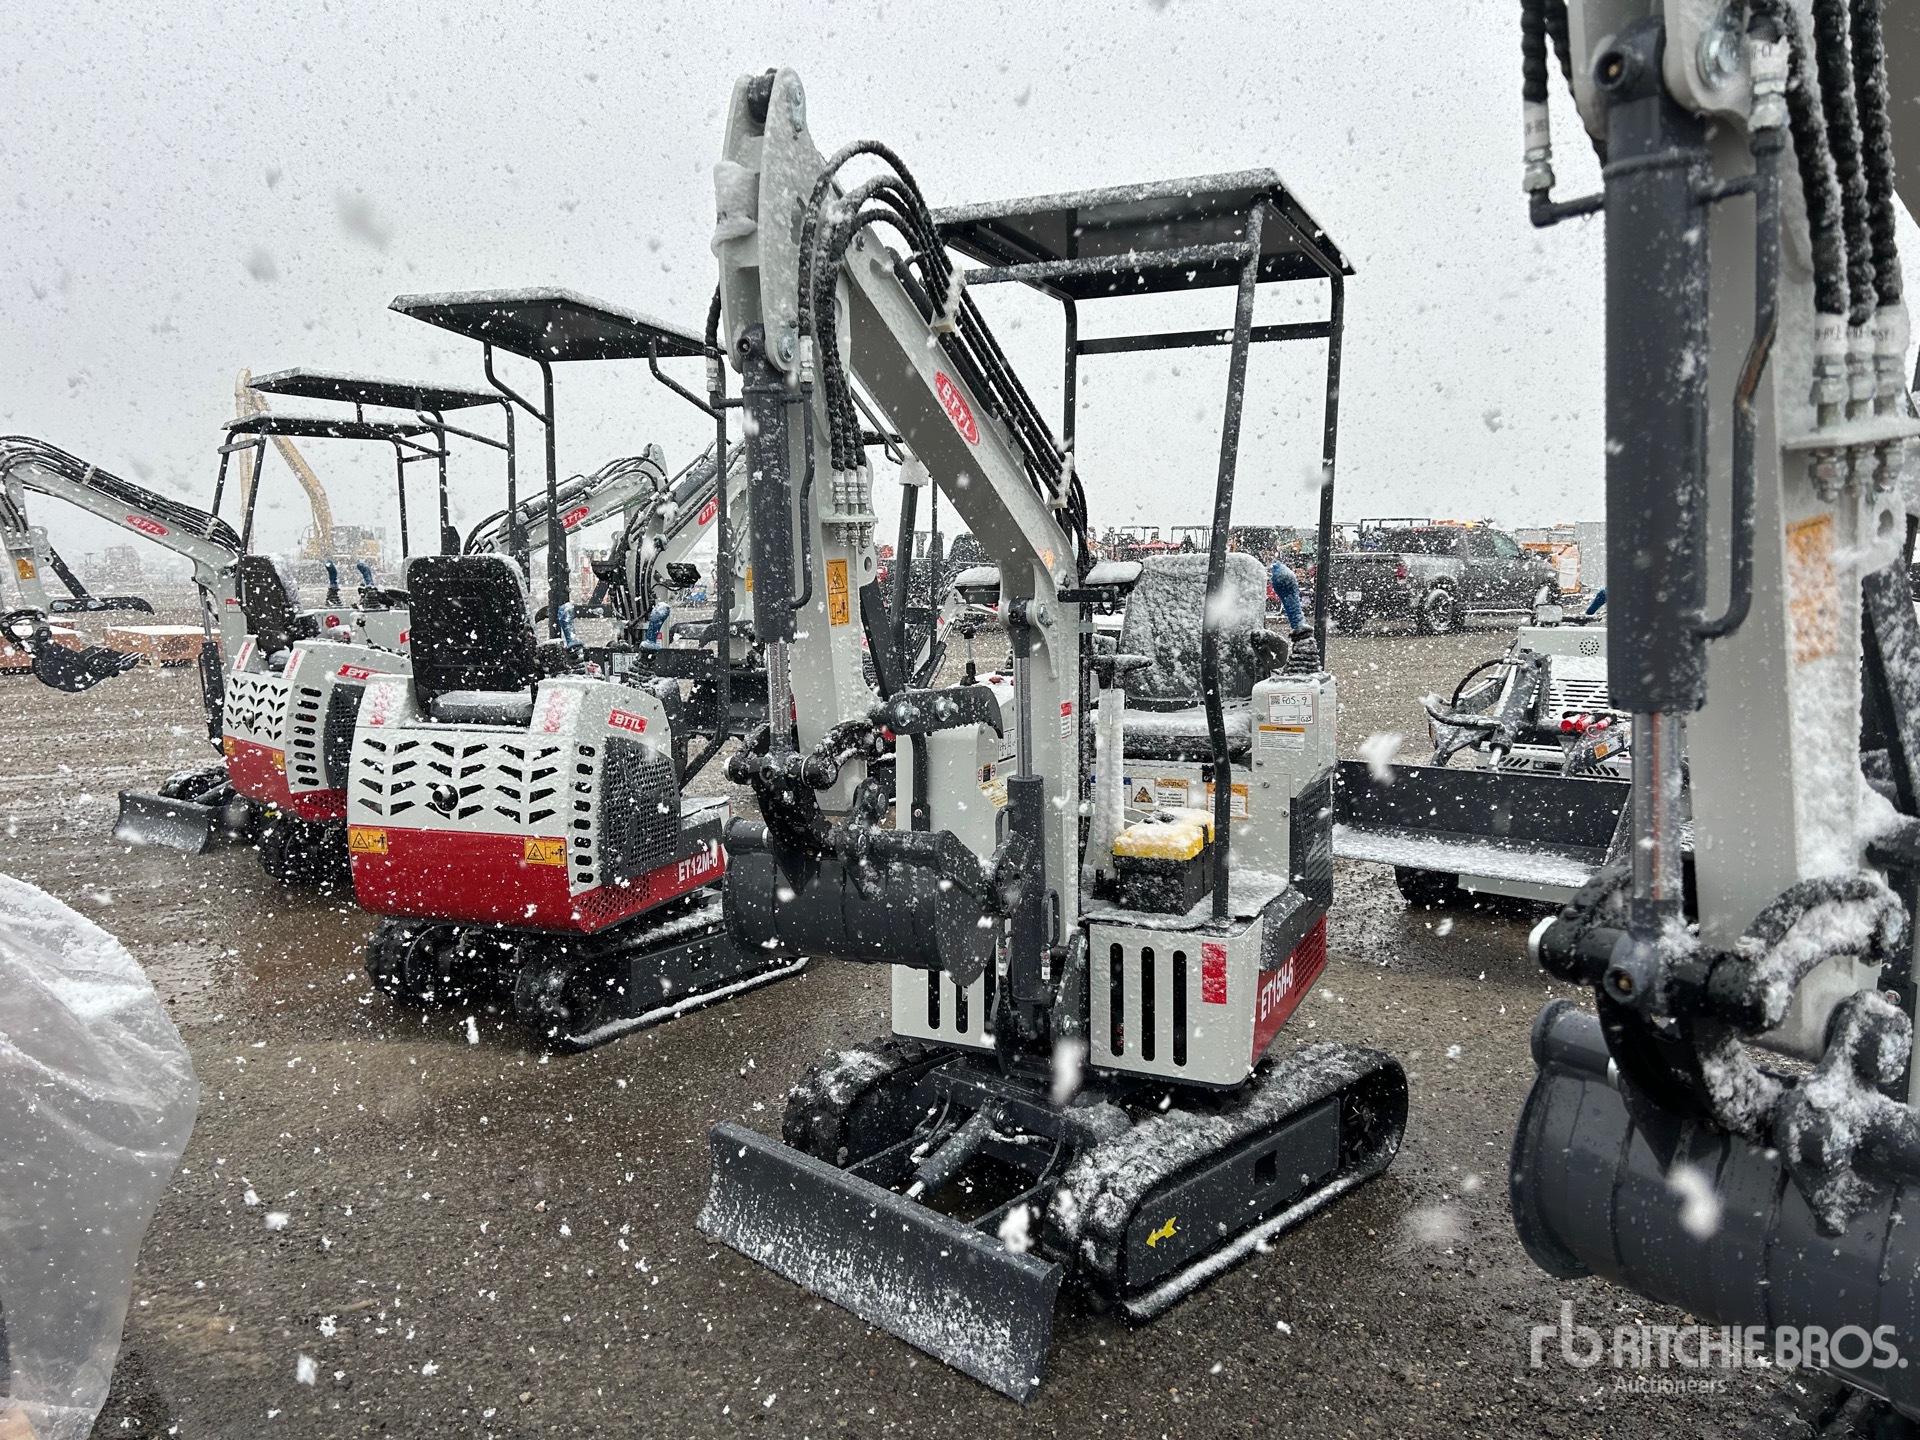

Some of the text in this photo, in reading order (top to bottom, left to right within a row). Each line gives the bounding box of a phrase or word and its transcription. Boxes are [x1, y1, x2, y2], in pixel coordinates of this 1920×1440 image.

[942, 382, 973, 437] BTTL
[614, 713, 641, 730] BTTL
[1261, 956, 1294, 1022] ET15H-6
